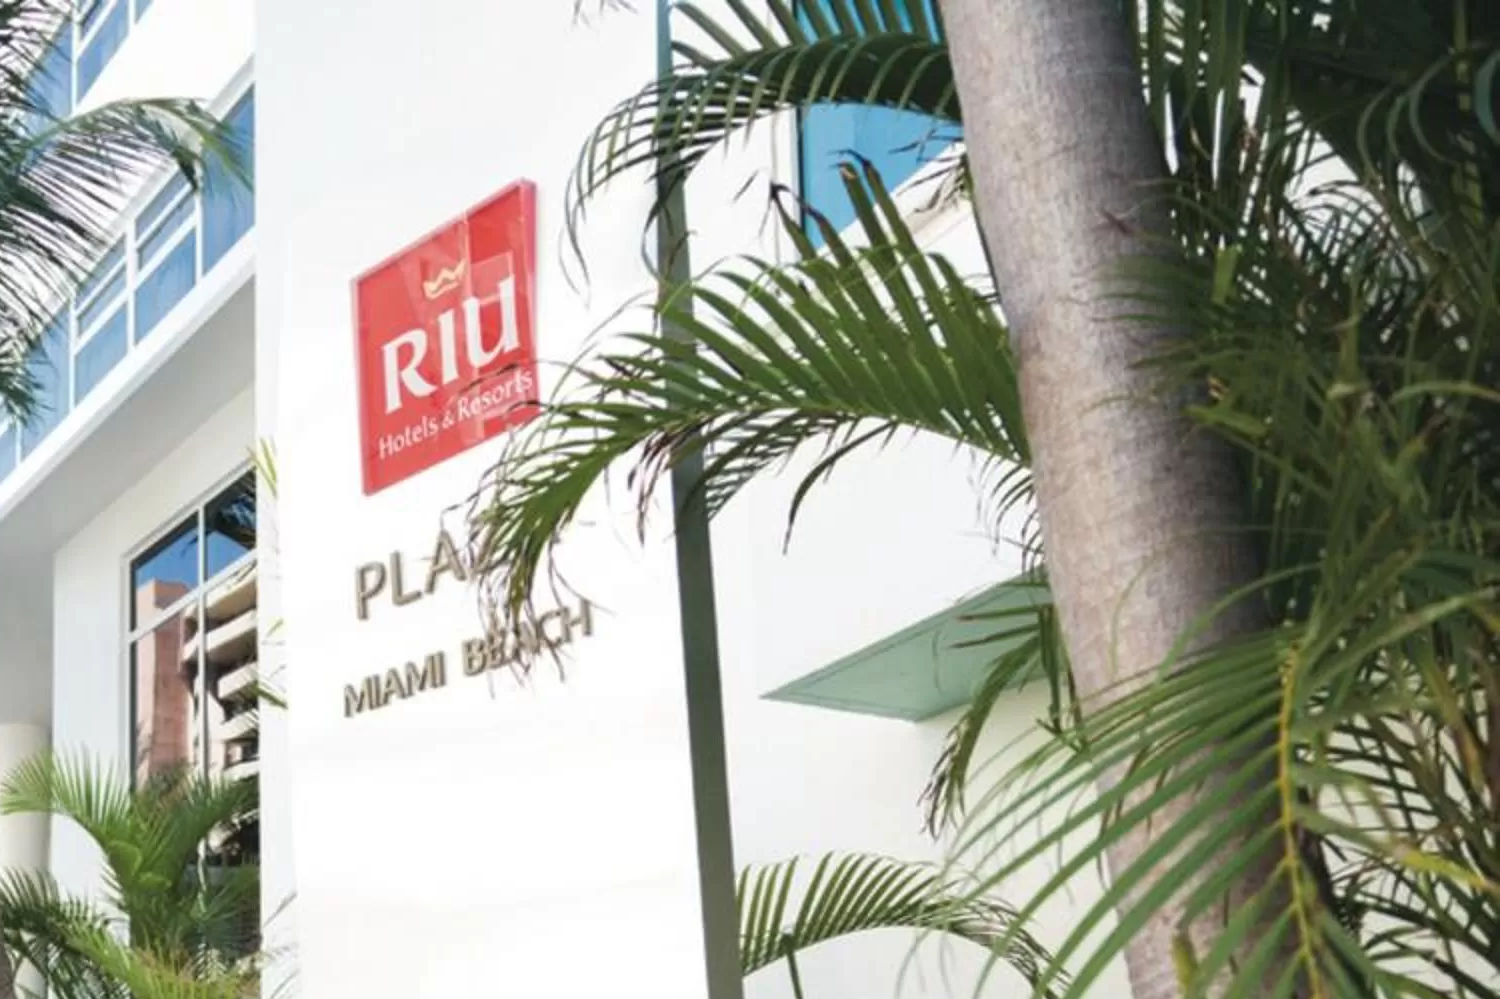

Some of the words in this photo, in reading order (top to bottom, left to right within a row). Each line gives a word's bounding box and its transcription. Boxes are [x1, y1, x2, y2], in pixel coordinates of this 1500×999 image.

[381, 273, 521, 415] RIU
[378, 415, 439, 460] Hotels
[441, 410, 455, 430] &
[457, 368, 534, 423] Resorts
[355, 512, 506, 622] PLA
[344, 651, 447, 719] MIAMI
